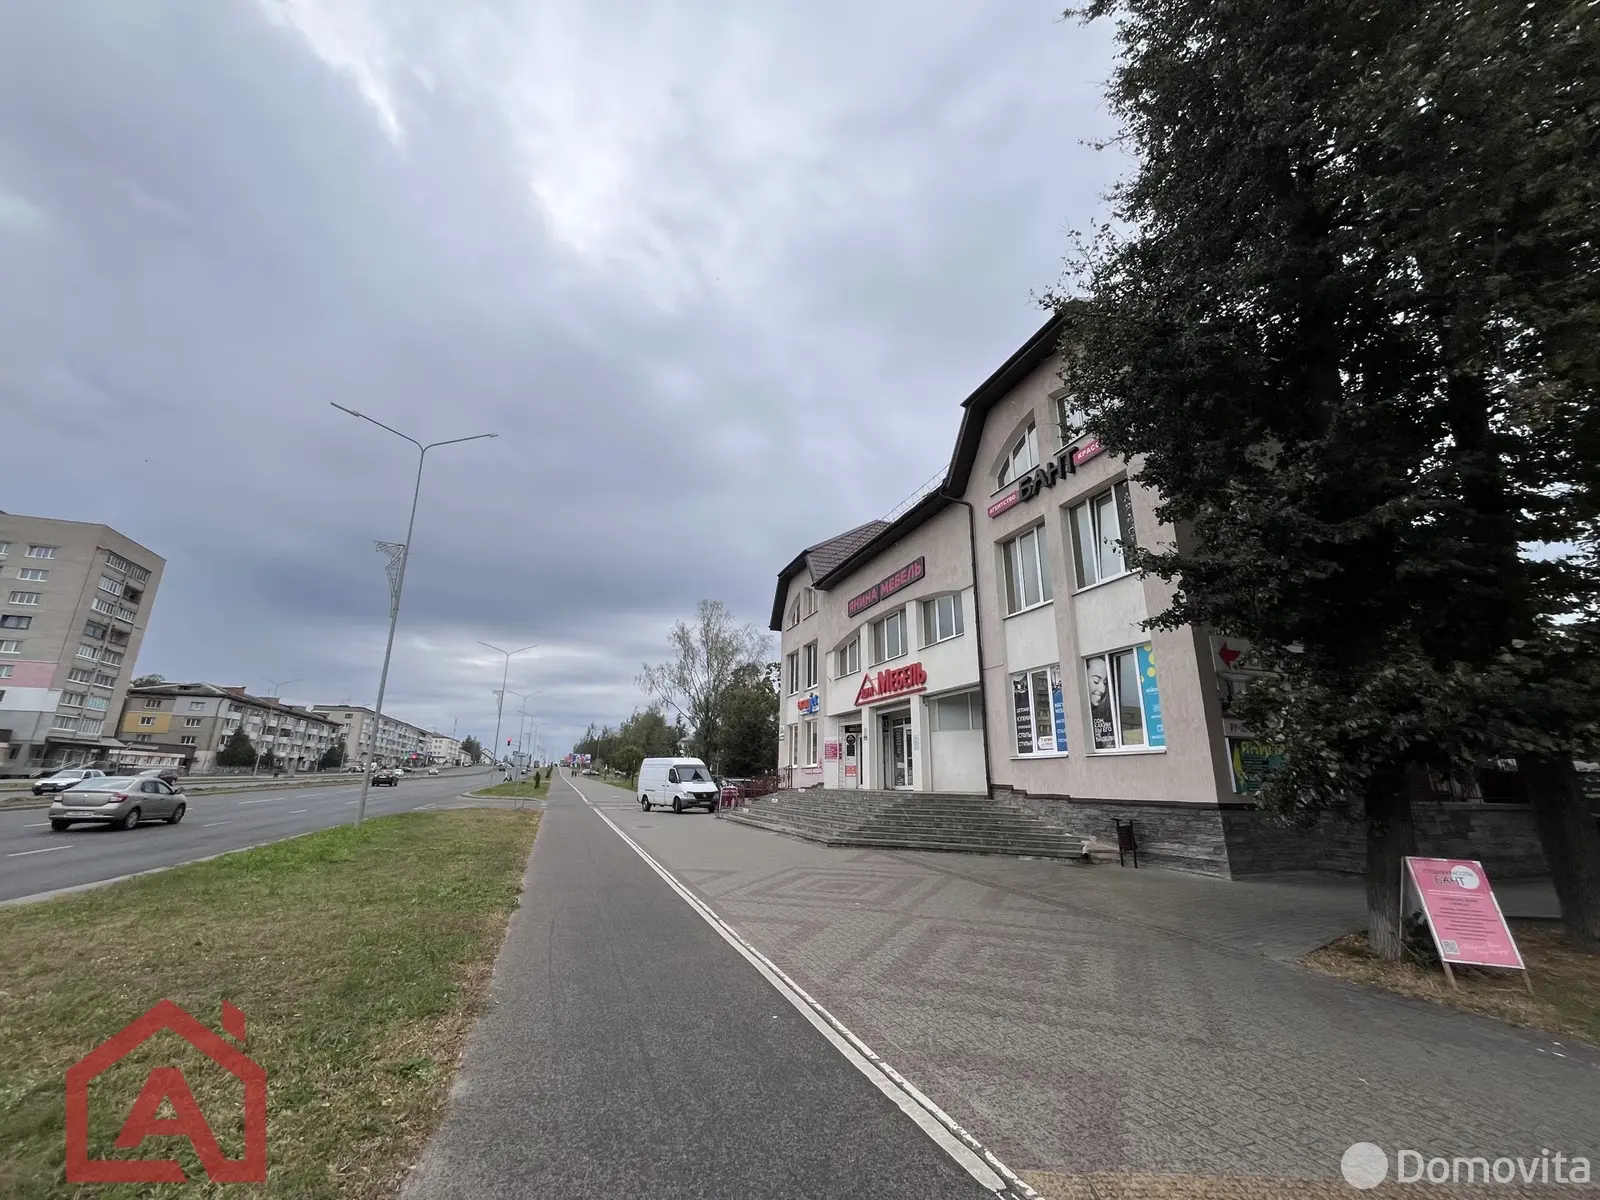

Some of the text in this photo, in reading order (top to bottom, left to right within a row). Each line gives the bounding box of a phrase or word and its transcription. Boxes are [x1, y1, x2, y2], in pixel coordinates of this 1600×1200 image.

[989, 441, 1100, 514] АГЕНТСТВО БАНТ КРАС
[849, 562, 921, 613] ЯНИНА МЕБЕЛЬ
[1434, 875, 1465, 887] БАНТ
